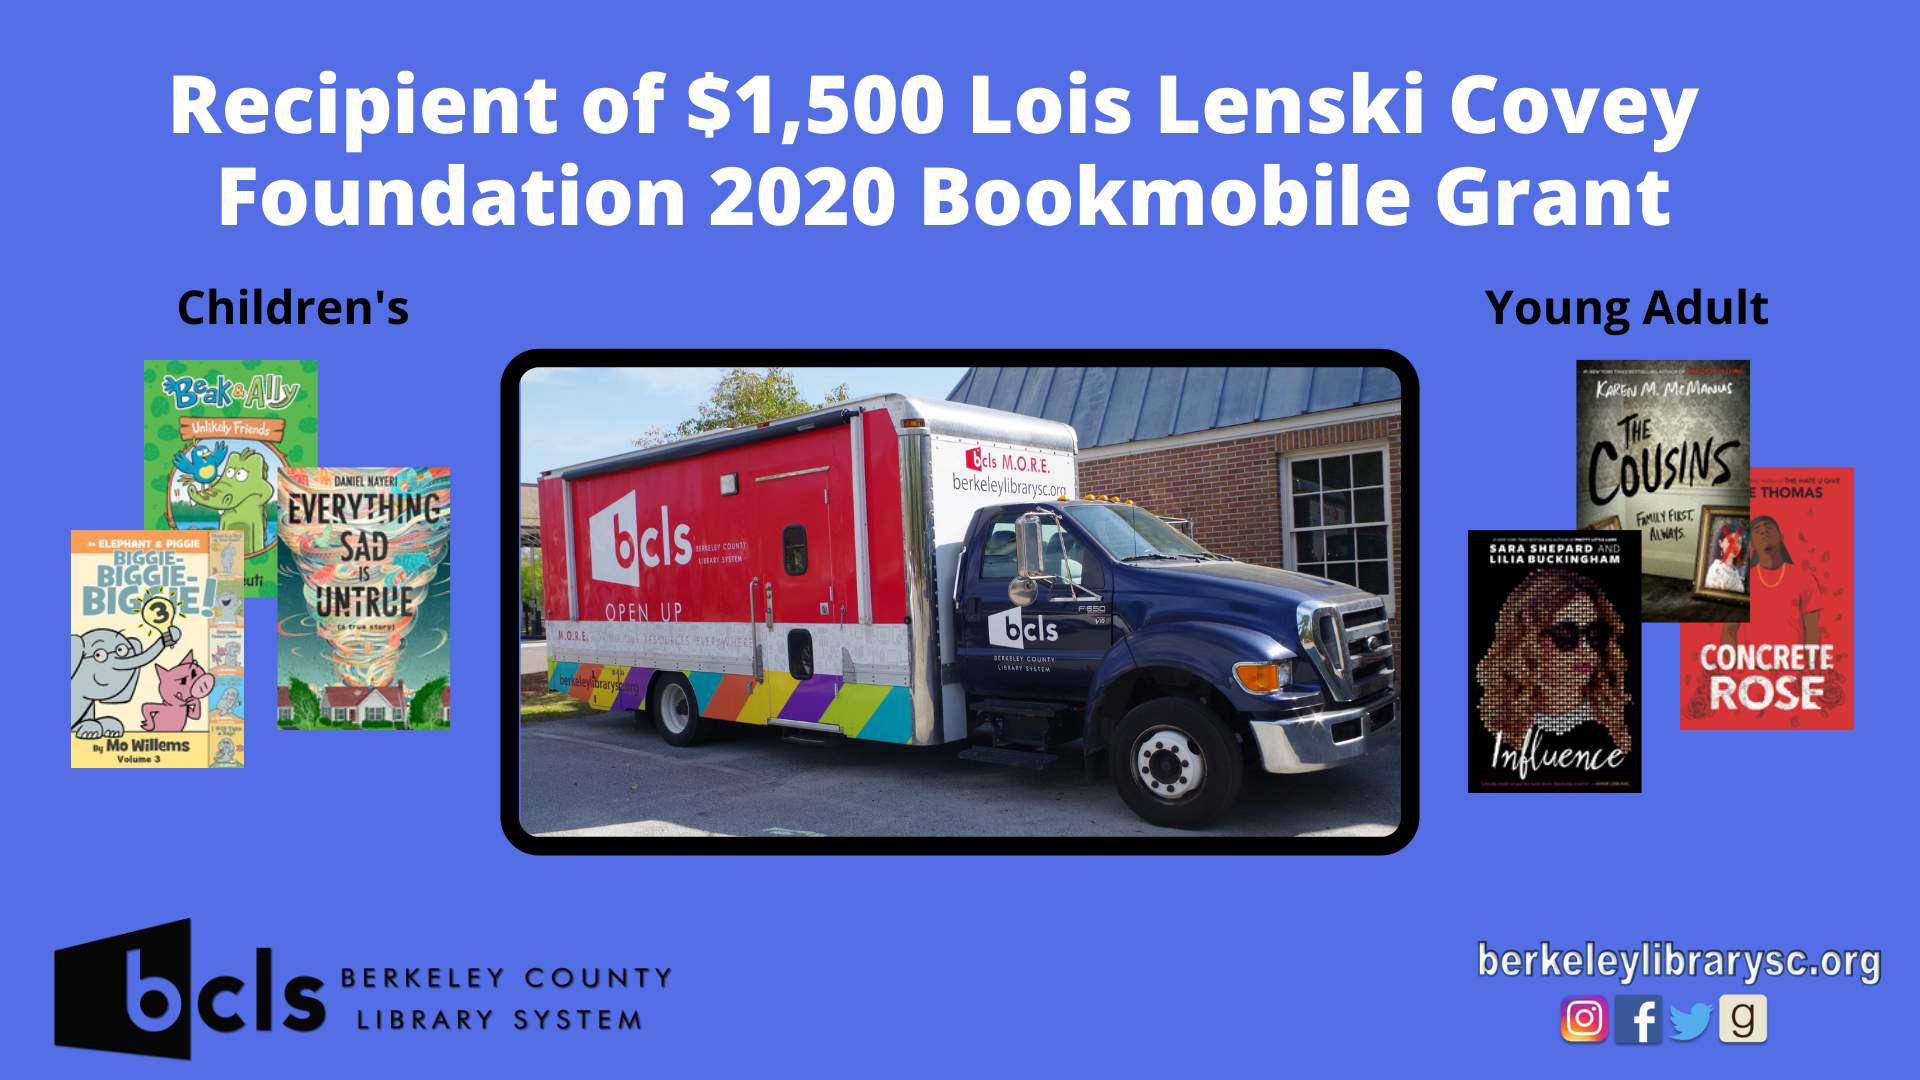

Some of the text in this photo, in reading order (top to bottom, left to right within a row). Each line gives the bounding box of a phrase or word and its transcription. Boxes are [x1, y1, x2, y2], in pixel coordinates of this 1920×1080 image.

[163, 374, 299, 409] Beak & Ally
[1640, 381, 1659, 397] M.
[191, 421, 270, 436] Unlikely Friends
[1617, 413, 1651, 448] THE
[1002, 454, 1050, 473] M.O.R.E.
[335, 475, 398, 487] DANIEL NAYERI
[952, 472, 1066, 499] berkeleylibrarysc.org
[1761, 487, 1823, 498] THOMAS
[289, 493, 440, 524] EVERYTHING
[98, 539, 152, 548] ELEPHANT
[155, 540, 163, 548] &
[166, 539, 201, 548] PIGGIE
[340, 531, 388, 561] SAD
[614, 505, 692, 569] bcls
[696, 542, 746, 552] BERKELEY COUNTY
[1489, 544, 1620, 553] SARA SHEPARD AND
[113, 549, 184, 566] BIGGIE-
[699, 555, 743, 564] LIBRARY SYSTEM
[1489, 555, 1620, 564] LILIA BUCKINGHAM
[97, 564, 198, 587] BIGGIE-
[359, 566, 370, 582] IS
[316, 586, 413, 617] UNTRUE
[149, 601, 170, 624] 3
[605, 602, 682, 622] OPEN UP
[1005, 615, 1059, 641] bcls
[558, 630, 753, 649] M.O.R.E. MOVING OUR RESOURCES EVERYWHERE
[1700, 644, 1834, 671] CONCRETE
[559, 673, 639, 696] berkeleylibrarysc.org
[1710, 675, 1825, 710] ROSE
[93, 739, 190, 754] By Mo Willems
[1492, 726, 1624, 780] Influence
[117, 755, 161, 763] Volume 3
